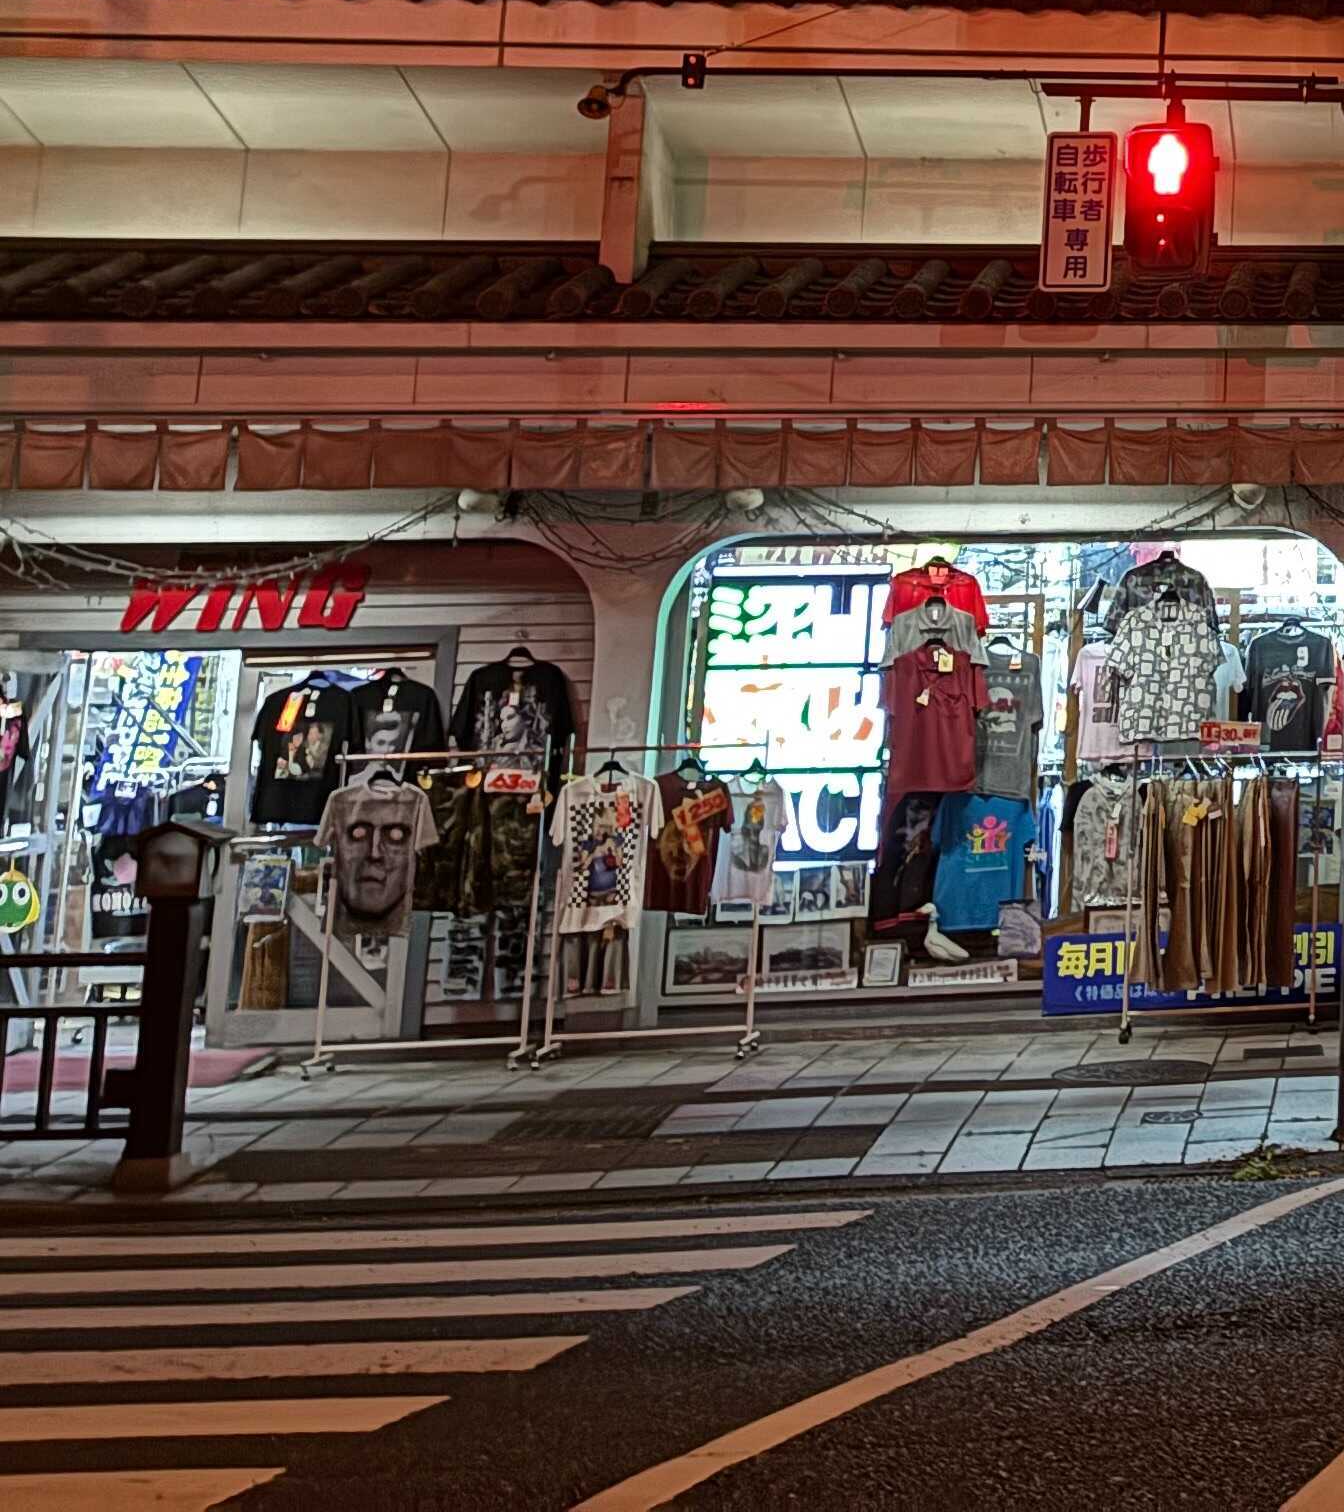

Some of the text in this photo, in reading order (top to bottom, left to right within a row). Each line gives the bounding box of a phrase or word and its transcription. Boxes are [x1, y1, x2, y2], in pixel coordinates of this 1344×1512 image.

[1051, 144, 1080, 222] 自転車
[1079, 144, 1109, 222] 歩行者
[1062, 227, 1090, 279] 専用
[119, 564, 372, 634] WING
